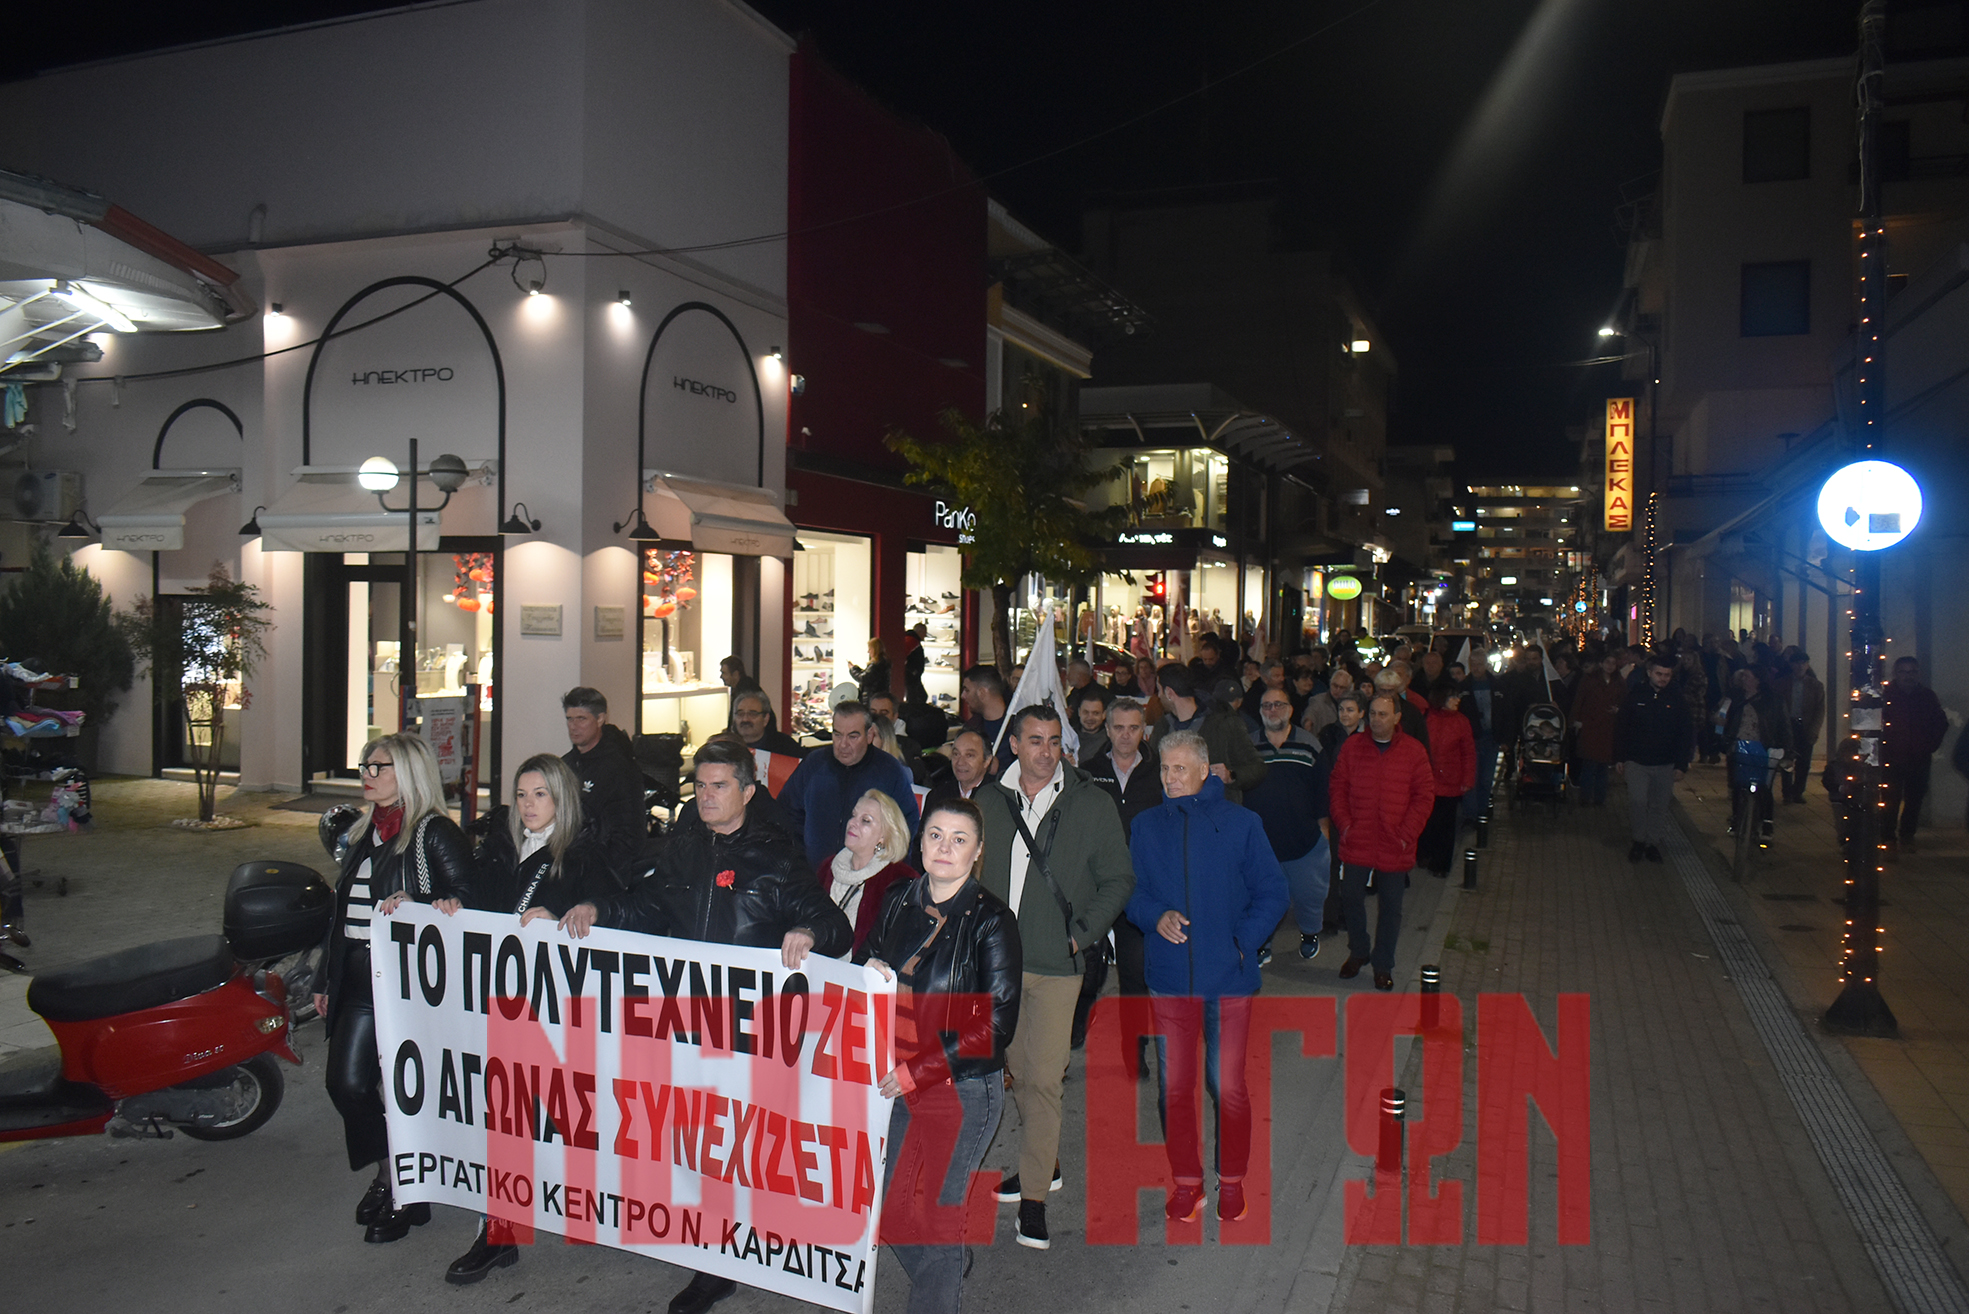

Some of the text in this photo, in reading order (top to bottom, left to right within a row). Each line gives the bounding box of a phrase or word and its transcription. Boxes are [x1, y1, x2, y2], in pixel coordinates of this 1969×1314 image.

[1608, 401, 1630, 528] ΜΠΛΕΚΑΣ
[518, 881, 539, 913] CHIARA
[390, 921, 889, 1085] ΤΟ ΠΟΛΥΤΕΧΝΕΙΟ ΖΕΙ
[393, 1039, 885, 1215] Ο ΑΓΩΝΑΣ ΣΥΝΕΧΙΖΕΤΑ
[395, 1151, 534, 1207] ΕΡΓΑΤΙΚΟ
[543, 1181, 671, 1239] ΚΕΝΤΡΟ
[681, 1210, 709, 1250] Ν.
